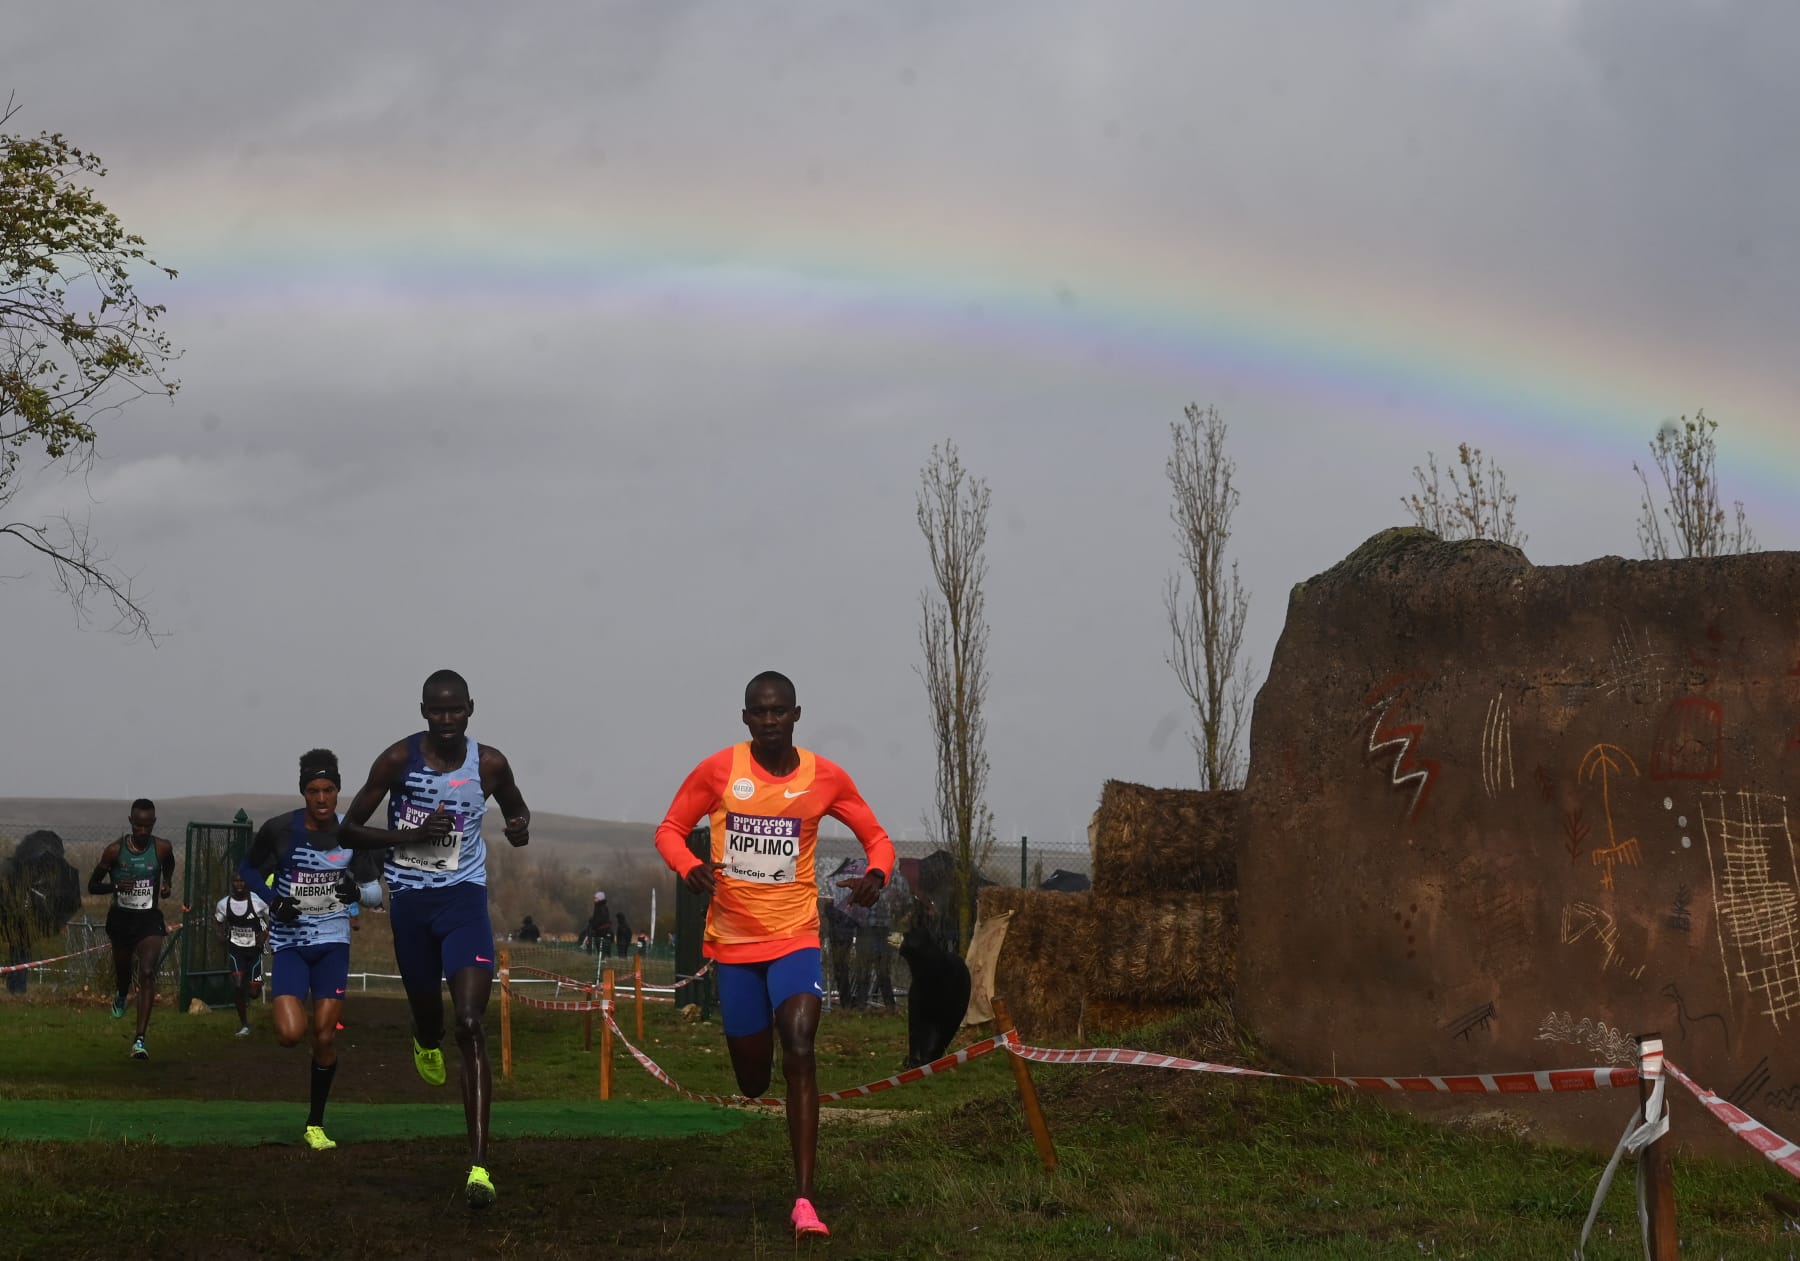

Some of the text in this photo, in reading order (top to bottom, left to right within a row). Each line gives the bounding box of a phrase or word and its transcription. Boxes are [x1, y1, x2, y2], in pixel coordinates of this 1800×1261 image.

[733, 815, 793, 828] DIPUTACIÓN
[733, 823, 793, 836] BURGOS
[729, 834, 794, 856] KIPLIMO
[294, 884, 336, 897] MEBRAH
